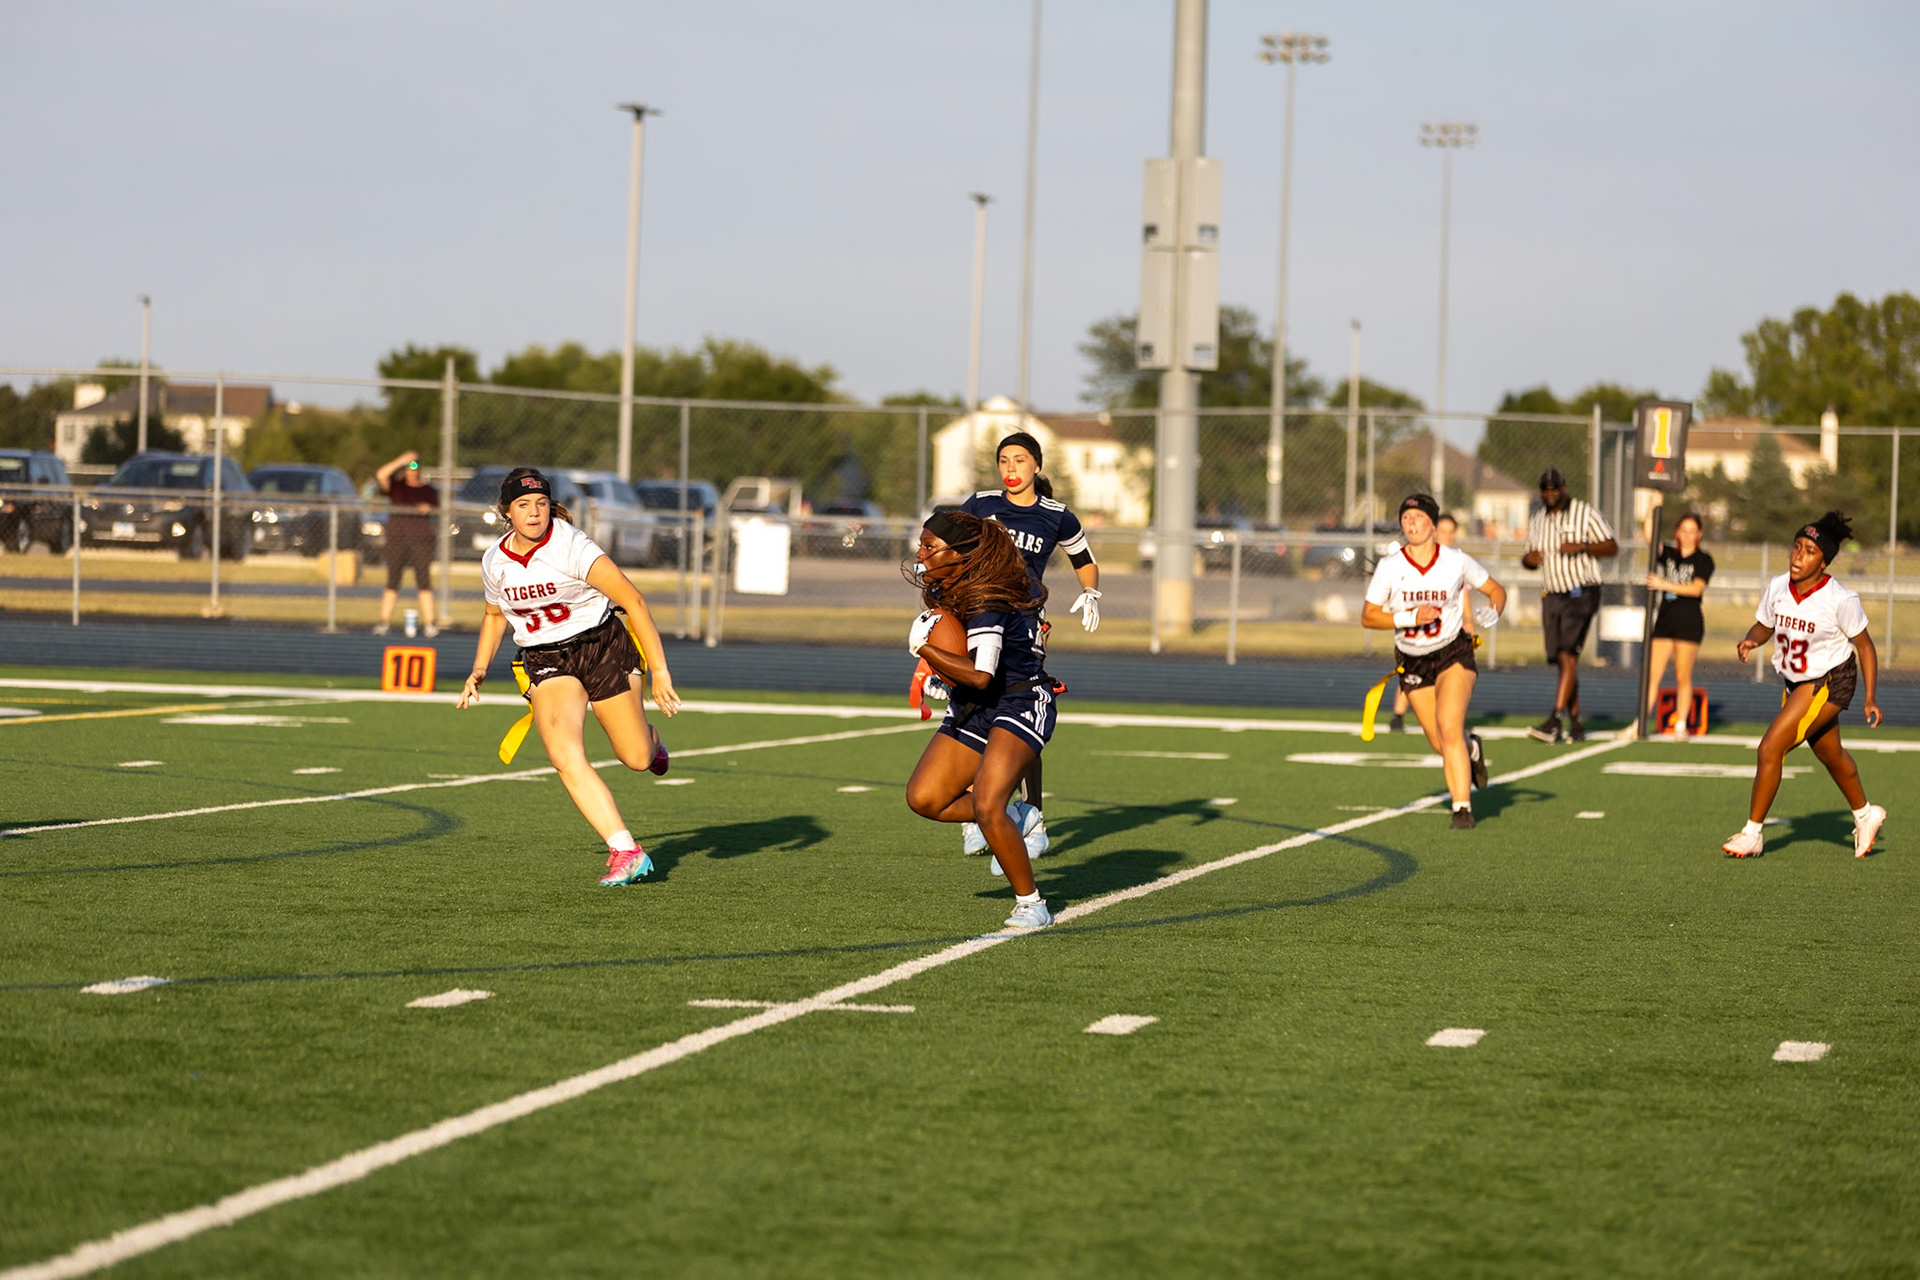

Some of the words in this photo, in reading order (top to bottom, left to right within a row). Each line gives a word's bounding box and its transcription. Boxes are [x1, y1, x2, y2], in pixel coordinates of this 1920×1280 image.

[1652, 407, 1672, 459] 1
[504, 582, 557, 601] TIGERS
[1402, 590, 1447, 602] TIGERS
[1774, 613, 1816, 634] TIGERS
[393, 655, 425, 688] 10
[1662, 694, 1703, 729] 20
